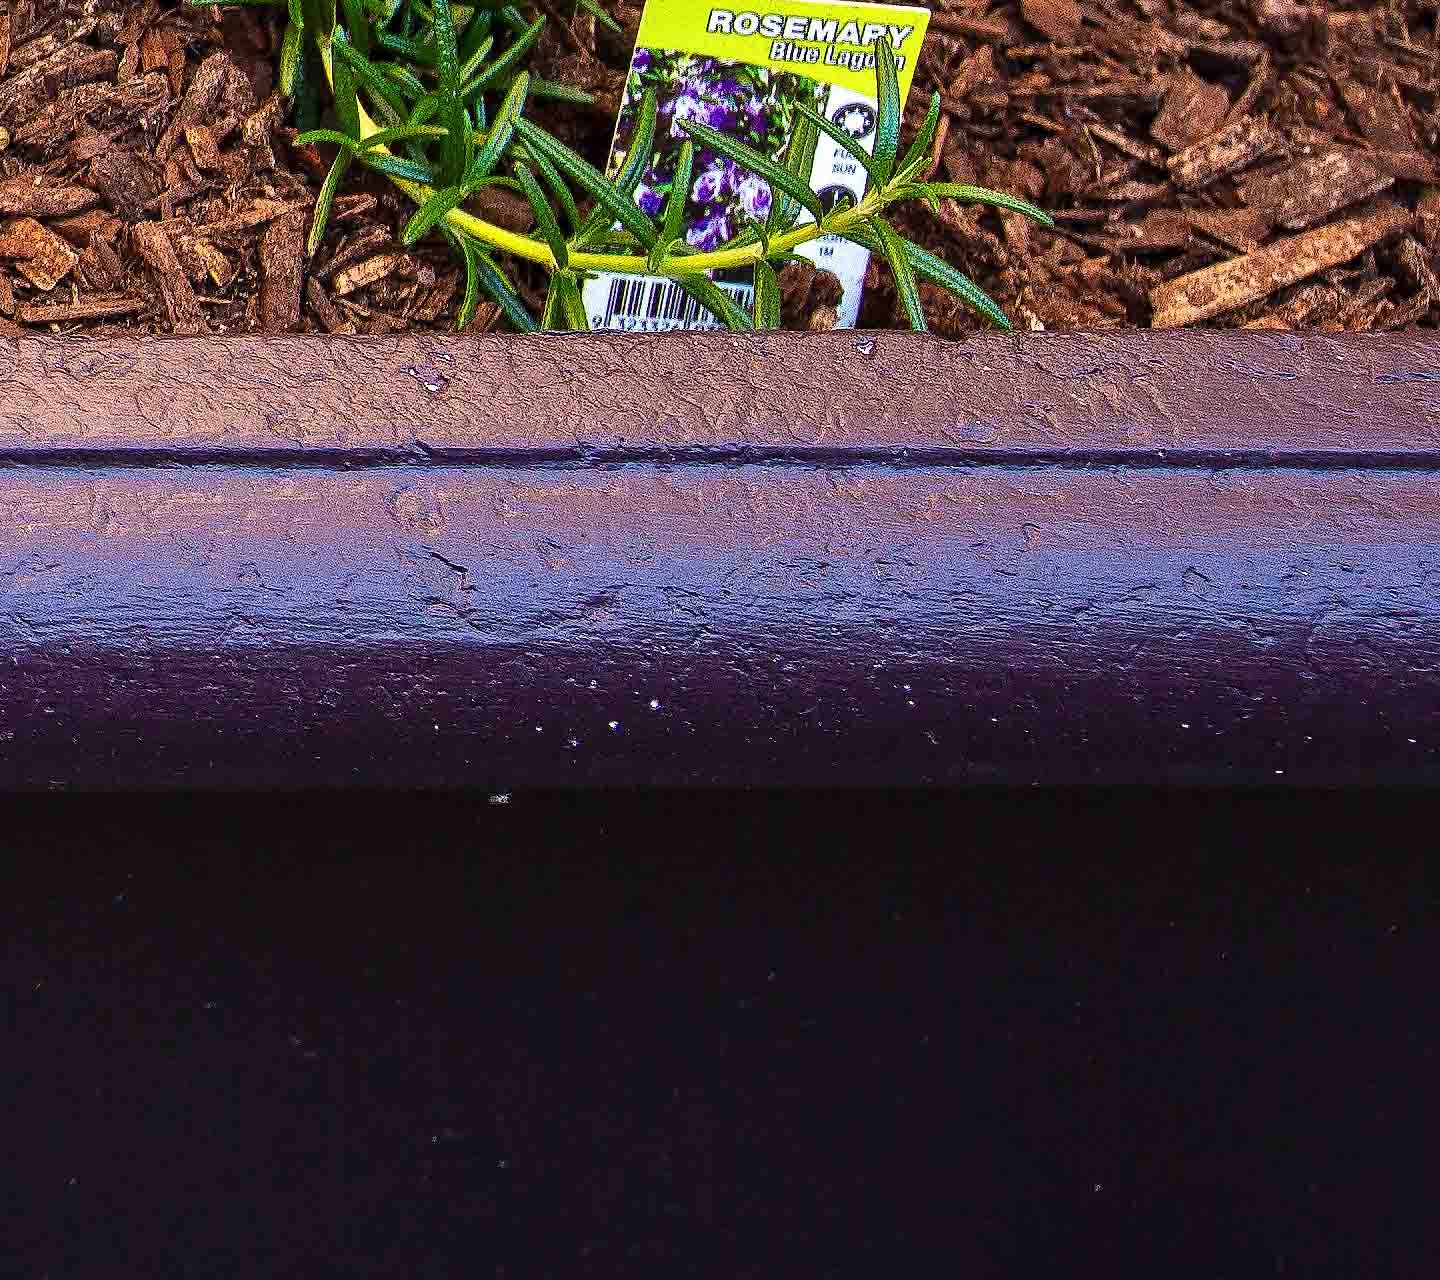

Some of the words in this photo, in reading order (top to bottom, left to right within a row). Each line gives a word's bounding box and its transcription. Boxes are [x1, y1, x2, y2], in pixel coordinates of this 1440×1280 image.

[706, 8, 914, 49] ROSEMARY
[768, 39, 820, 64] Blue
[823, 44, 906, 72] Lagon
